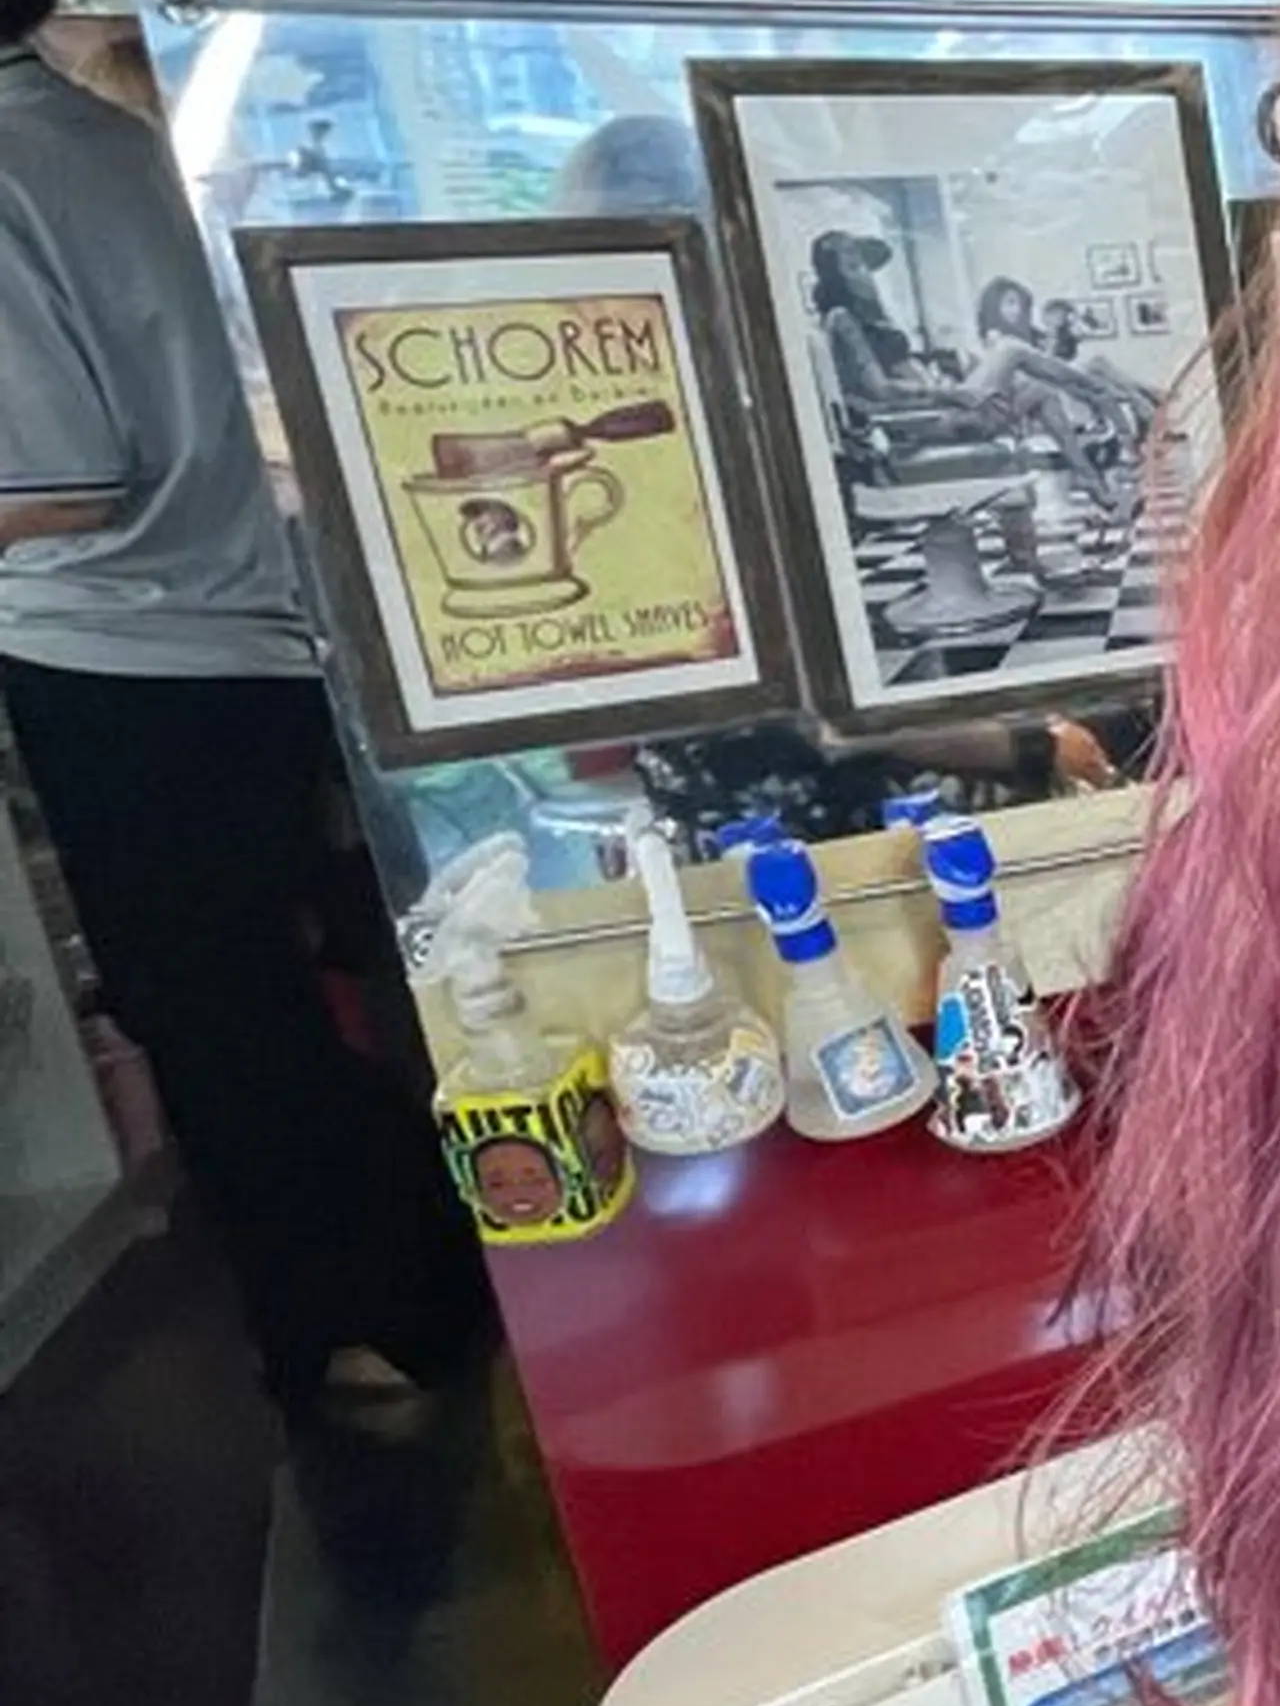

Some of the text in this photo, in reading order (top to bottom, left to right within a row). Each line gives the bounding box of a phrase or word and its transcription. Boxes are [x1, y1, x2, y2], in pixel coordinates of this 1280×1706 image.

[355, 317, 660, 391] SCHOREM
[439, 600, 708, 663] HOT TOWEL SHAVES
